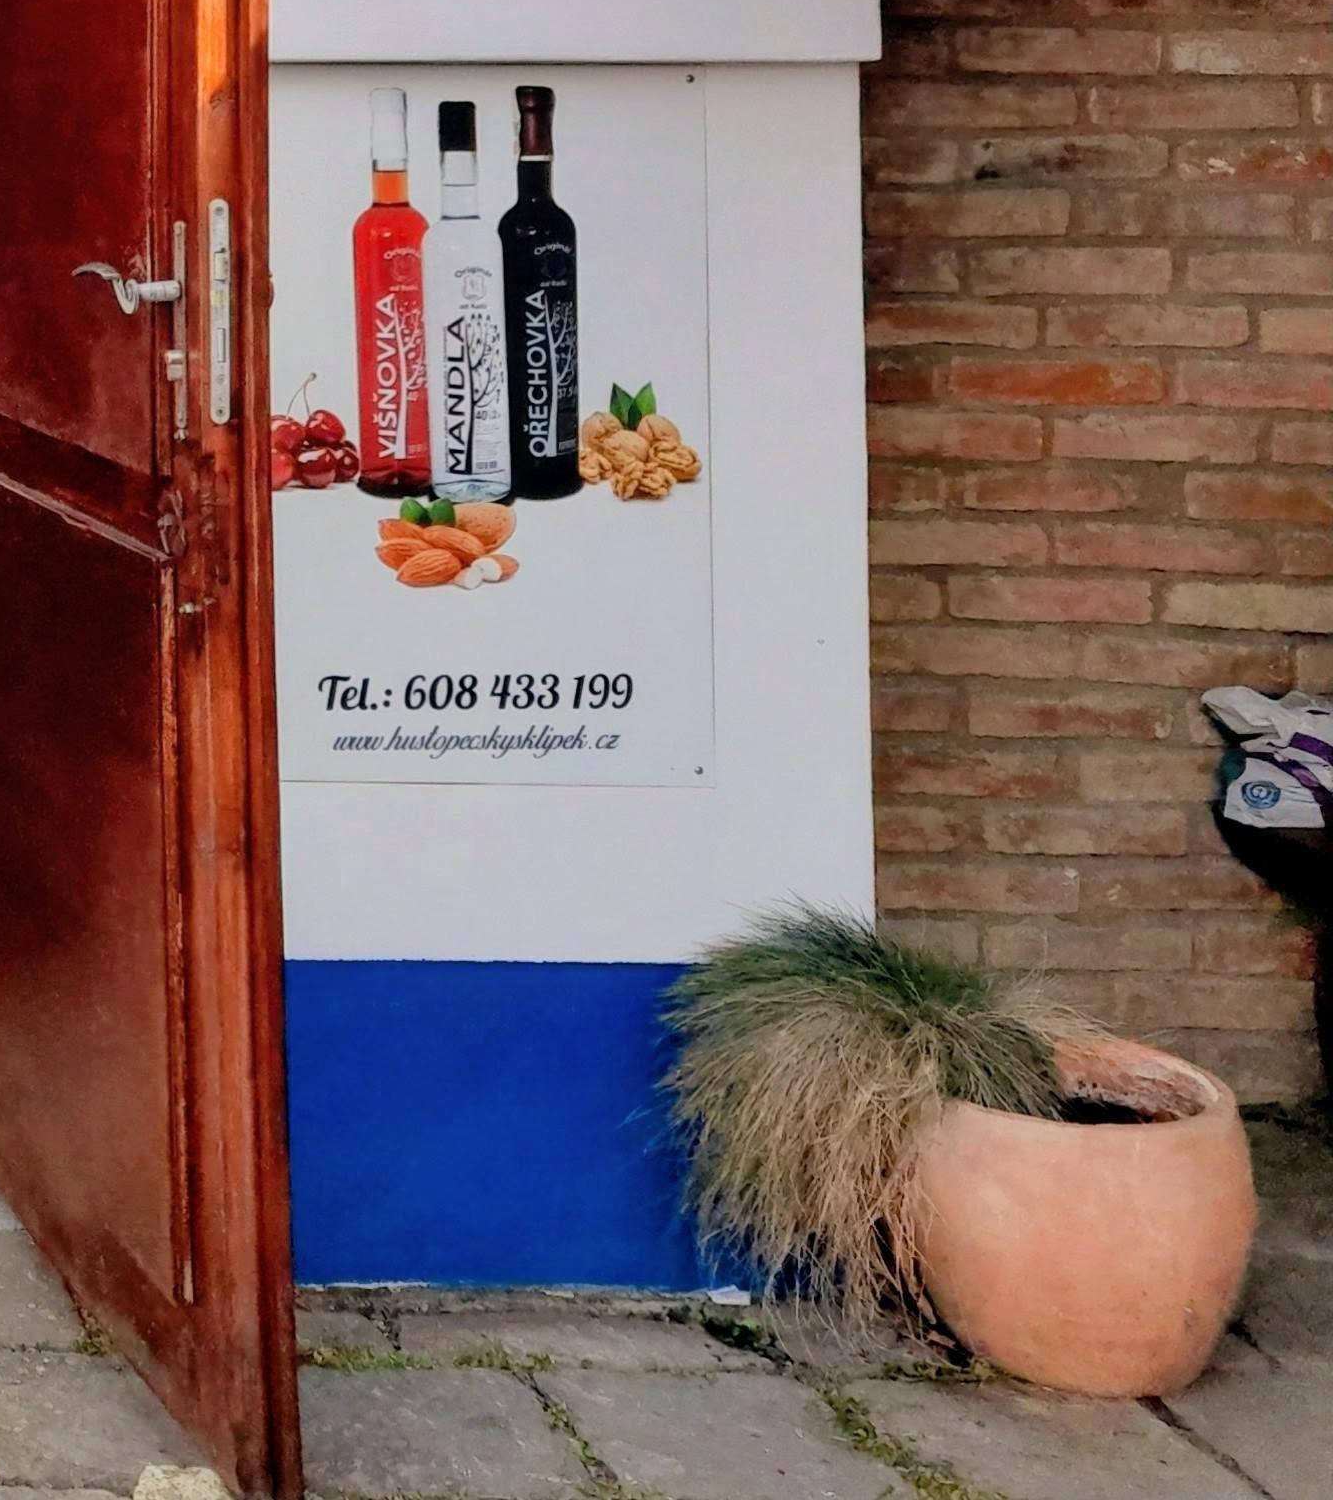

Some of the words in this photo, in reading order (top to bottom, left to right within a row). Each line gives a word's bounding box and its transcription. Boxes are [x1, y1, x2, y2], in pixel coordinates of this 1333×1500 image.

[372, 293, 399, 459] VIŠŇOVKA
[446, 315, 466, 475] MANDLA
[523, 289, 549, 458] OŘECHOVKA
[318, 674, 392, 711] Tel.:
[404, 673, 479, 711] 608
[489, 673, 561, 710] 433
[572, 673, 634, 710] 199
